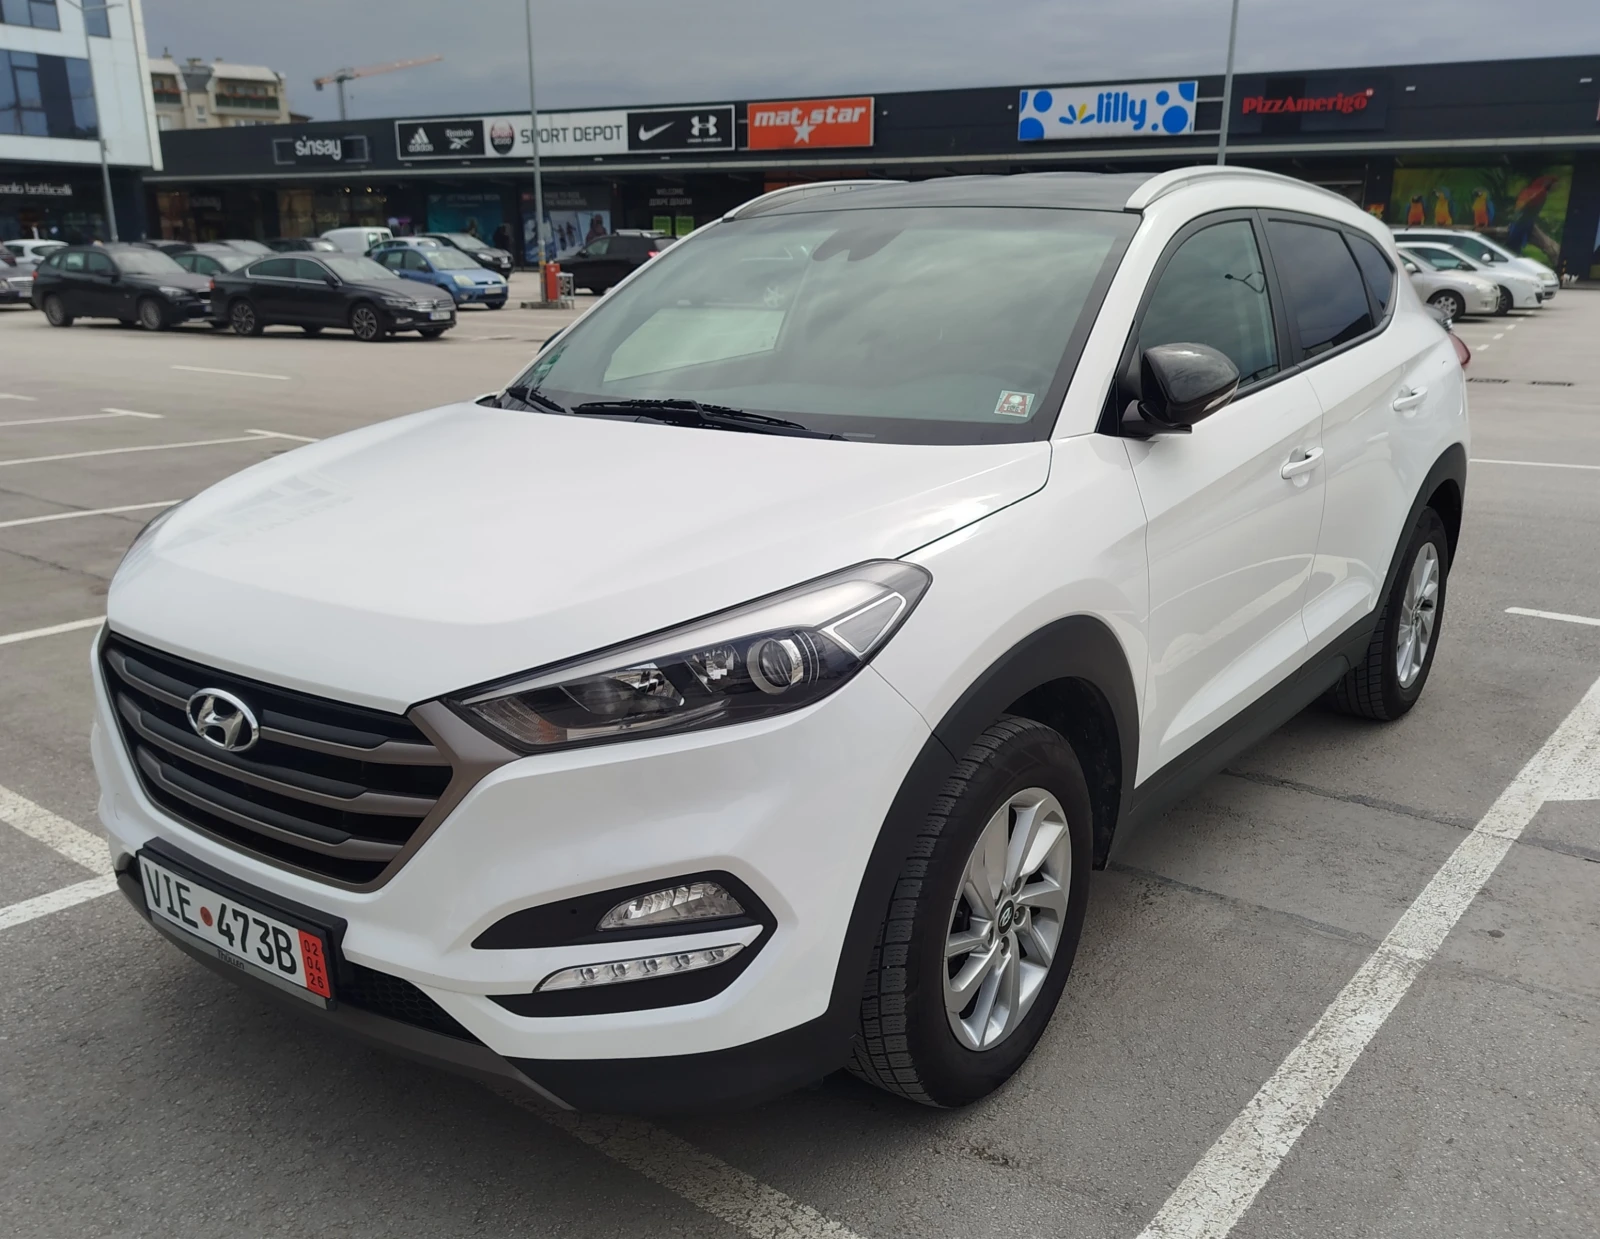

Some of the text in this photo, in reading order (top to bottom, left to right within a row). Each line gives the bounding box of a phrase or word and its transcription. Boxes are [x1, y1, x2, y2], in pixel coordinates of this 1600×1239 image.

[1095, 90, 1147, 129] lilly
[1241, 92, 1368, 115] PizzAmerigo
[753, 104, 866, 127] mat star
[520, 124, 623, 145] SPORT DEPOT
[295, 135, 342, 161] sinsay
[407, 143, 434, 153] adidas
[0, 181, 73, 196] aolo botticelli
[143, 863, 298, 976] VIE 473B
[303, 939, 319, 957] 02
[306, 956, 322, 973] 04
